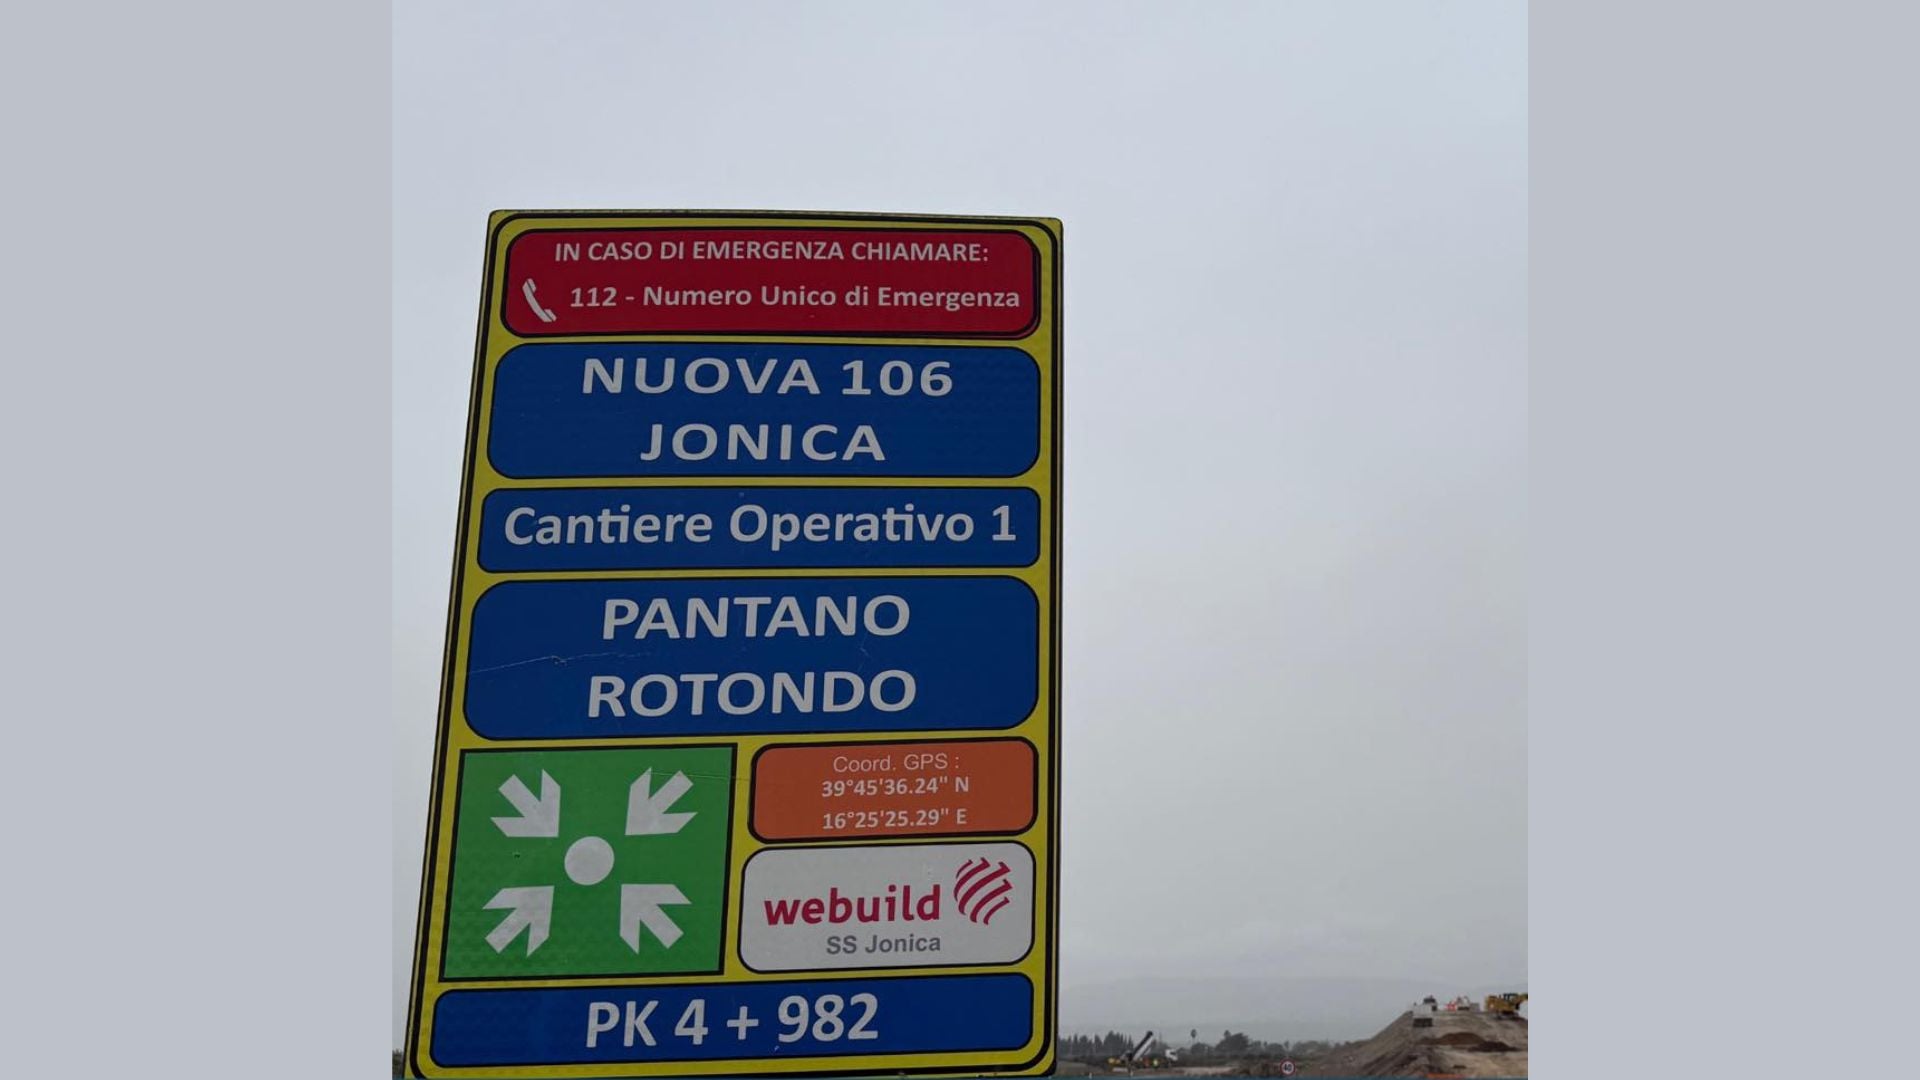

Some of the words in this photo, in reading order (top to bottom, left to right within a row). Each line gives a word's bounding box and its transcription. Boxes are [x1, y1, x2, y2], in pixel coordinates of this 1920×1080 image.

[556, 243, 579, 261] IN
[589, 242, 652, 260] CASO
[661, 242, 684, 259] DI
[694, 241, 844, 259] EMERGENZA
[851, 242, 989, 262] CHIAMARE:
[571, 287, 616, 307] 112
[644, 287, 751, 305] Numero
[762, 286, 835, 305] Unico
[846, 286, 868, 305] di
[879, 287, 1019, 311] Emergenza
[583, 358, 820, 394] NUOVA
[841, 360, 953, 396] 106
[641, 424, 885, 460] JONICA
[505, 505, 712, 544] Cantiere
[730, 504, 973, 551] Operativo
[991, 505, 1016, 541] 1
[603, 595, 909, 639] PANTANO
[589, 670, 916, 717] ROTONDO
[834, 755, 896, 772] Coord.
[904, 753, 947, 770] GPS
[956, 777, 968, 792] N
[957, 809, 966, 824] E
[764, 884, 940, 925] webuild
[827, 935, 856, 954] SS
[865, 934, 940, 953] Jonica
[587, 1001, 658, 1047] PK
[674, 999, 708, 1043] 4
[727, 1006, 758, 1040] +
[778, 993, 878, 1042] 982
